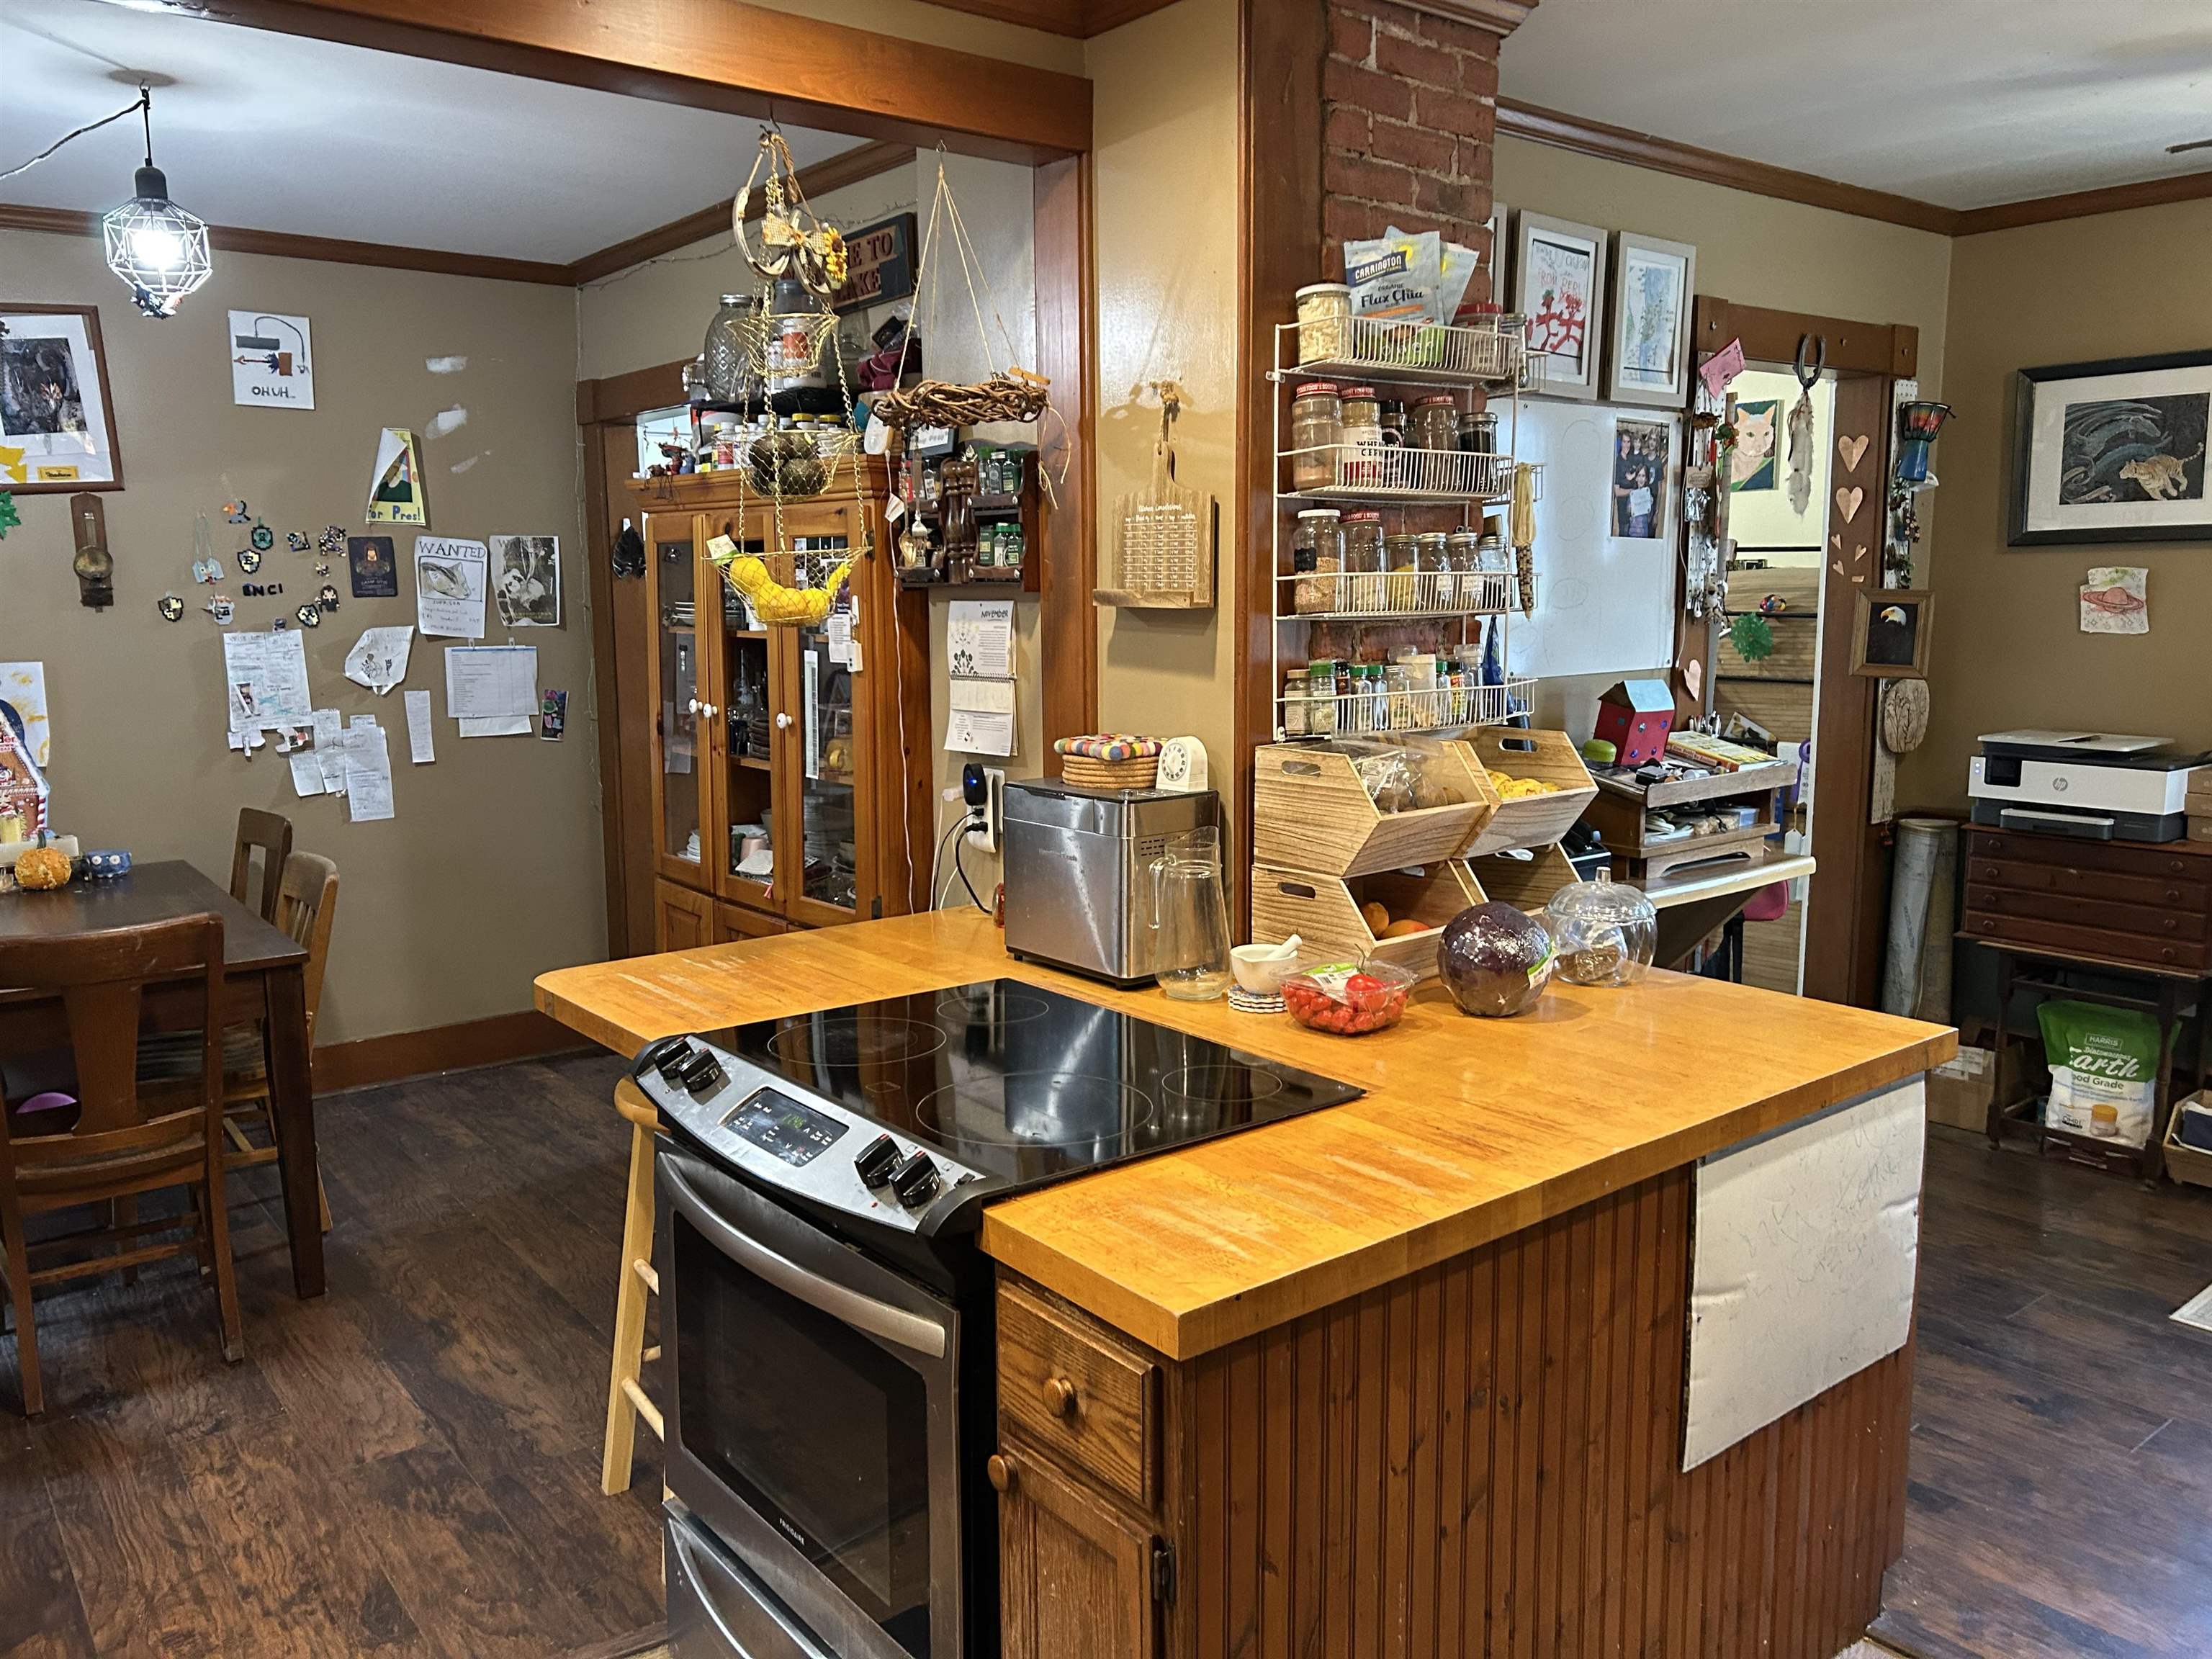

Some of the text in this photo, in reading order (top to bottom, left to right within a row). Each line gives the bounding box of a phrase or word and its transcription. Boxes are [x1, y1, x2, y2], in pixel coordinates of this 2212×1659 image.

[867, 233, 892, 261] TO
[1355, 256, 1401, 279] CARRINGTON
[1361, 289, 1423, 307] Flax Chia
[252, 386, 270, 396] OH
[392, 505, 421, 521] Pres!
[419, 541, 486, 559] WANTED
[981, 608, 1008, 619] NOVEMBER
[2054, 778, 2067, 791] hp
[2089, 1036, 2118, 1047] HARRIS
[2093, 1076, 2124, 1089] Grade
[779, 1517, 805, 1546] FRIGIDAIRE
